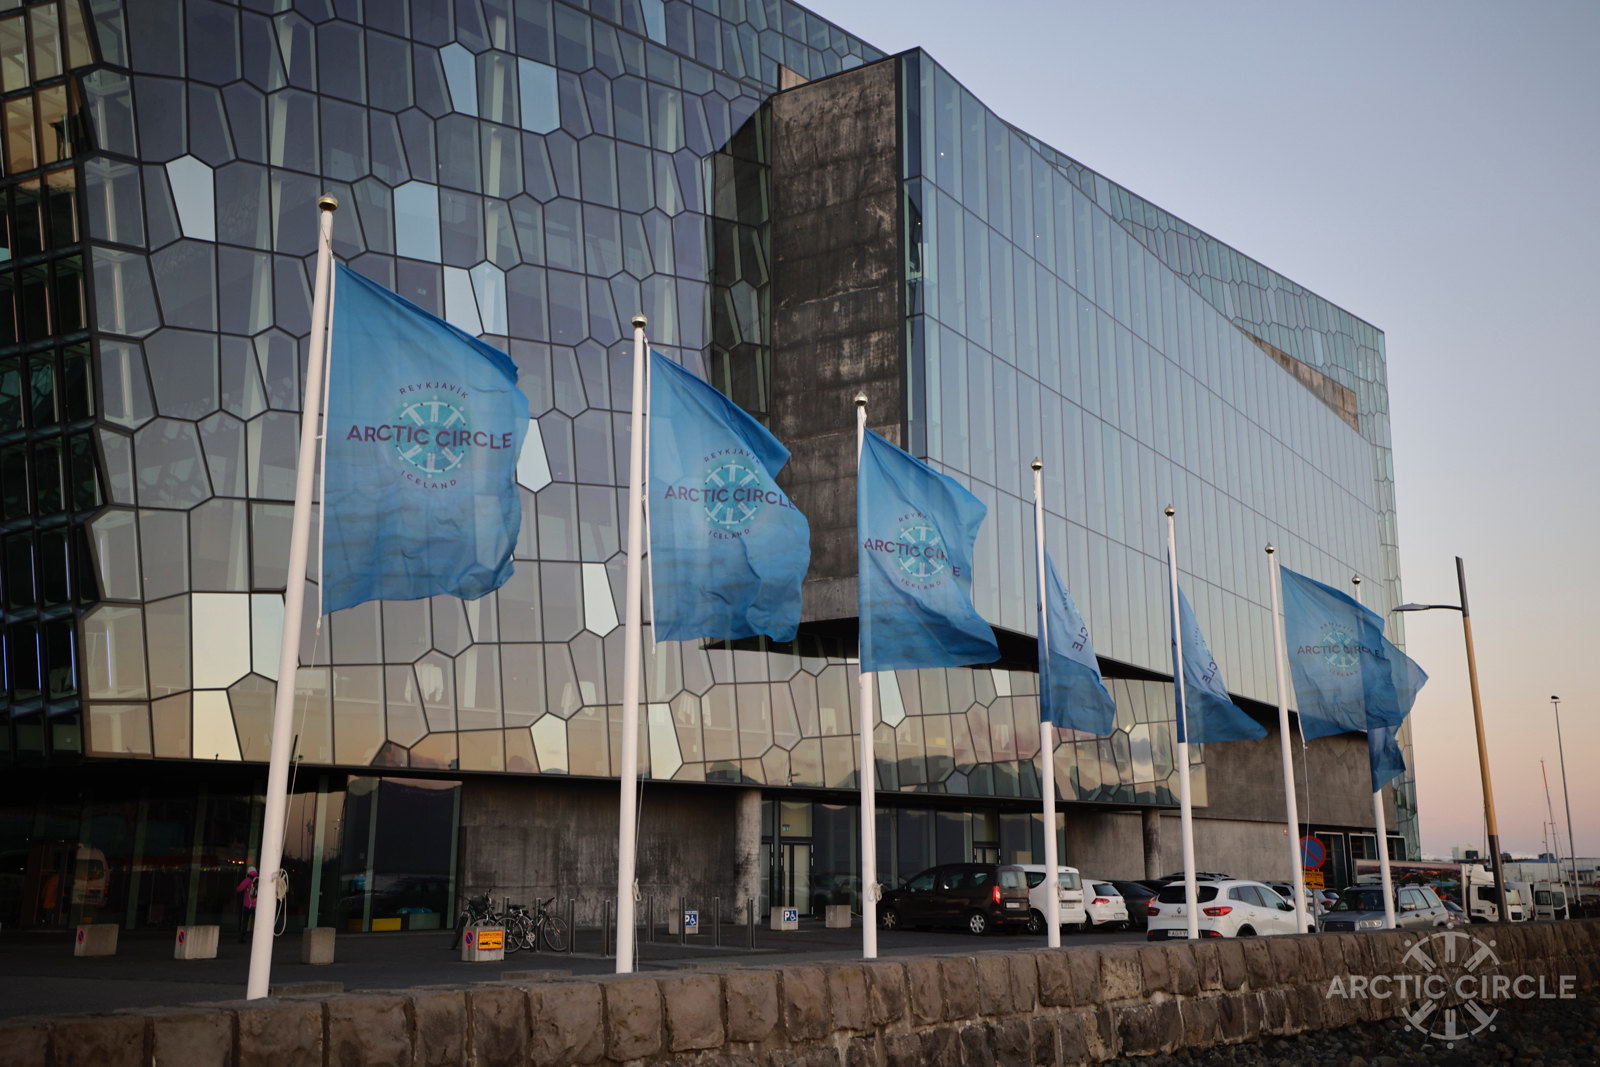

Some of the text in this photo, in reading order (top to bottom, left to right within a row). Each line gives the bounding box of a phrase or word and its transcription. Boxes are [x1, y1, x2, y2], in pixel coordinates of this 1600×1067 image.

[346, 424, 513, 450] ARCTIC CIRCLE
[401, 470, 457, 489] ICELAND
[664, 485, 729, 503] ARCTIC
[864, 538, 921, 558] ARCTIC
[1297, 644, 1341, 655] ARCTIC
